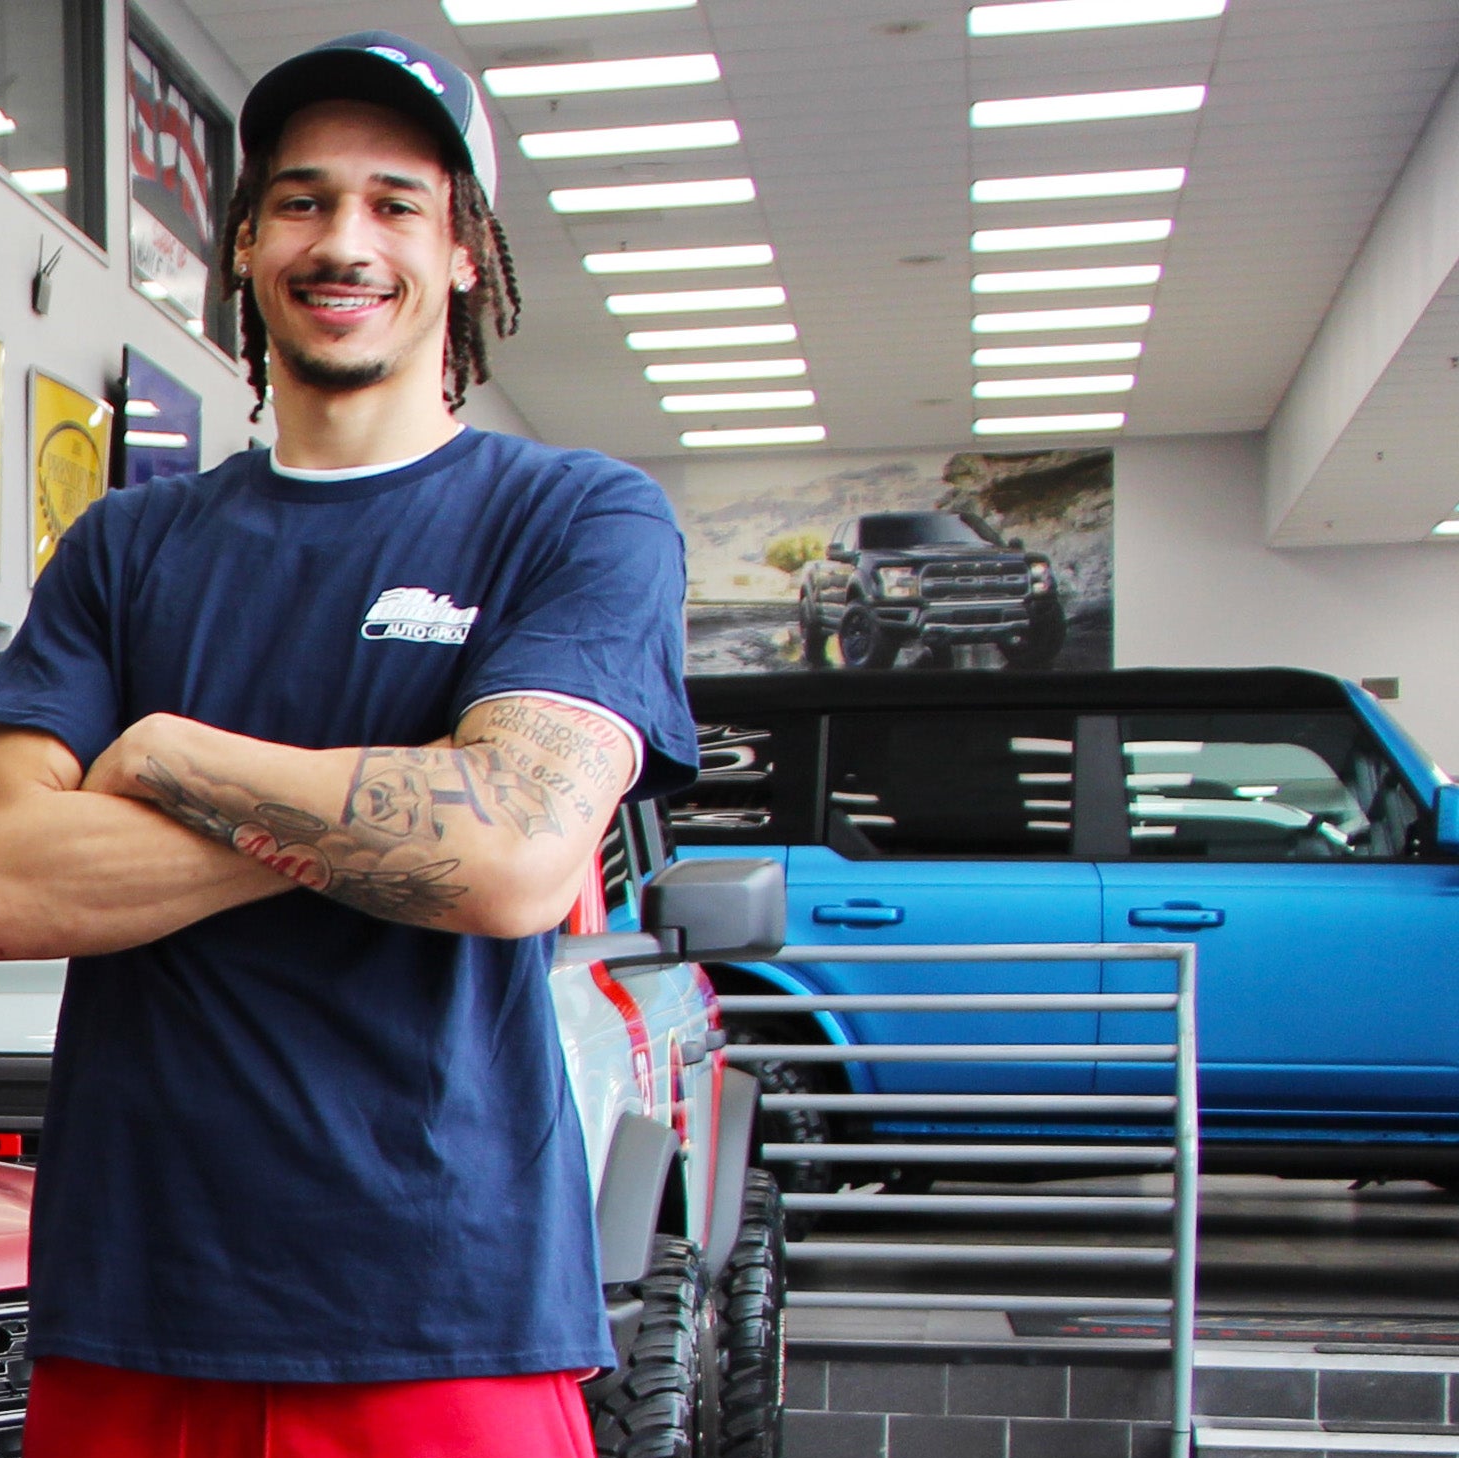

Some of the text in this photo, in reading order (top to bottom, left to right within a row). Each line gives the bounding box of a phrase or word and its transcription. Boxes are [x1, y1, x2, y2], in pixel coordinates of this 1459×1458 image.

[384, 622, 427, 639] AUTO
[489, 704, 528, 721] FOR
[486, 716, 577, 761] MISTREAT
